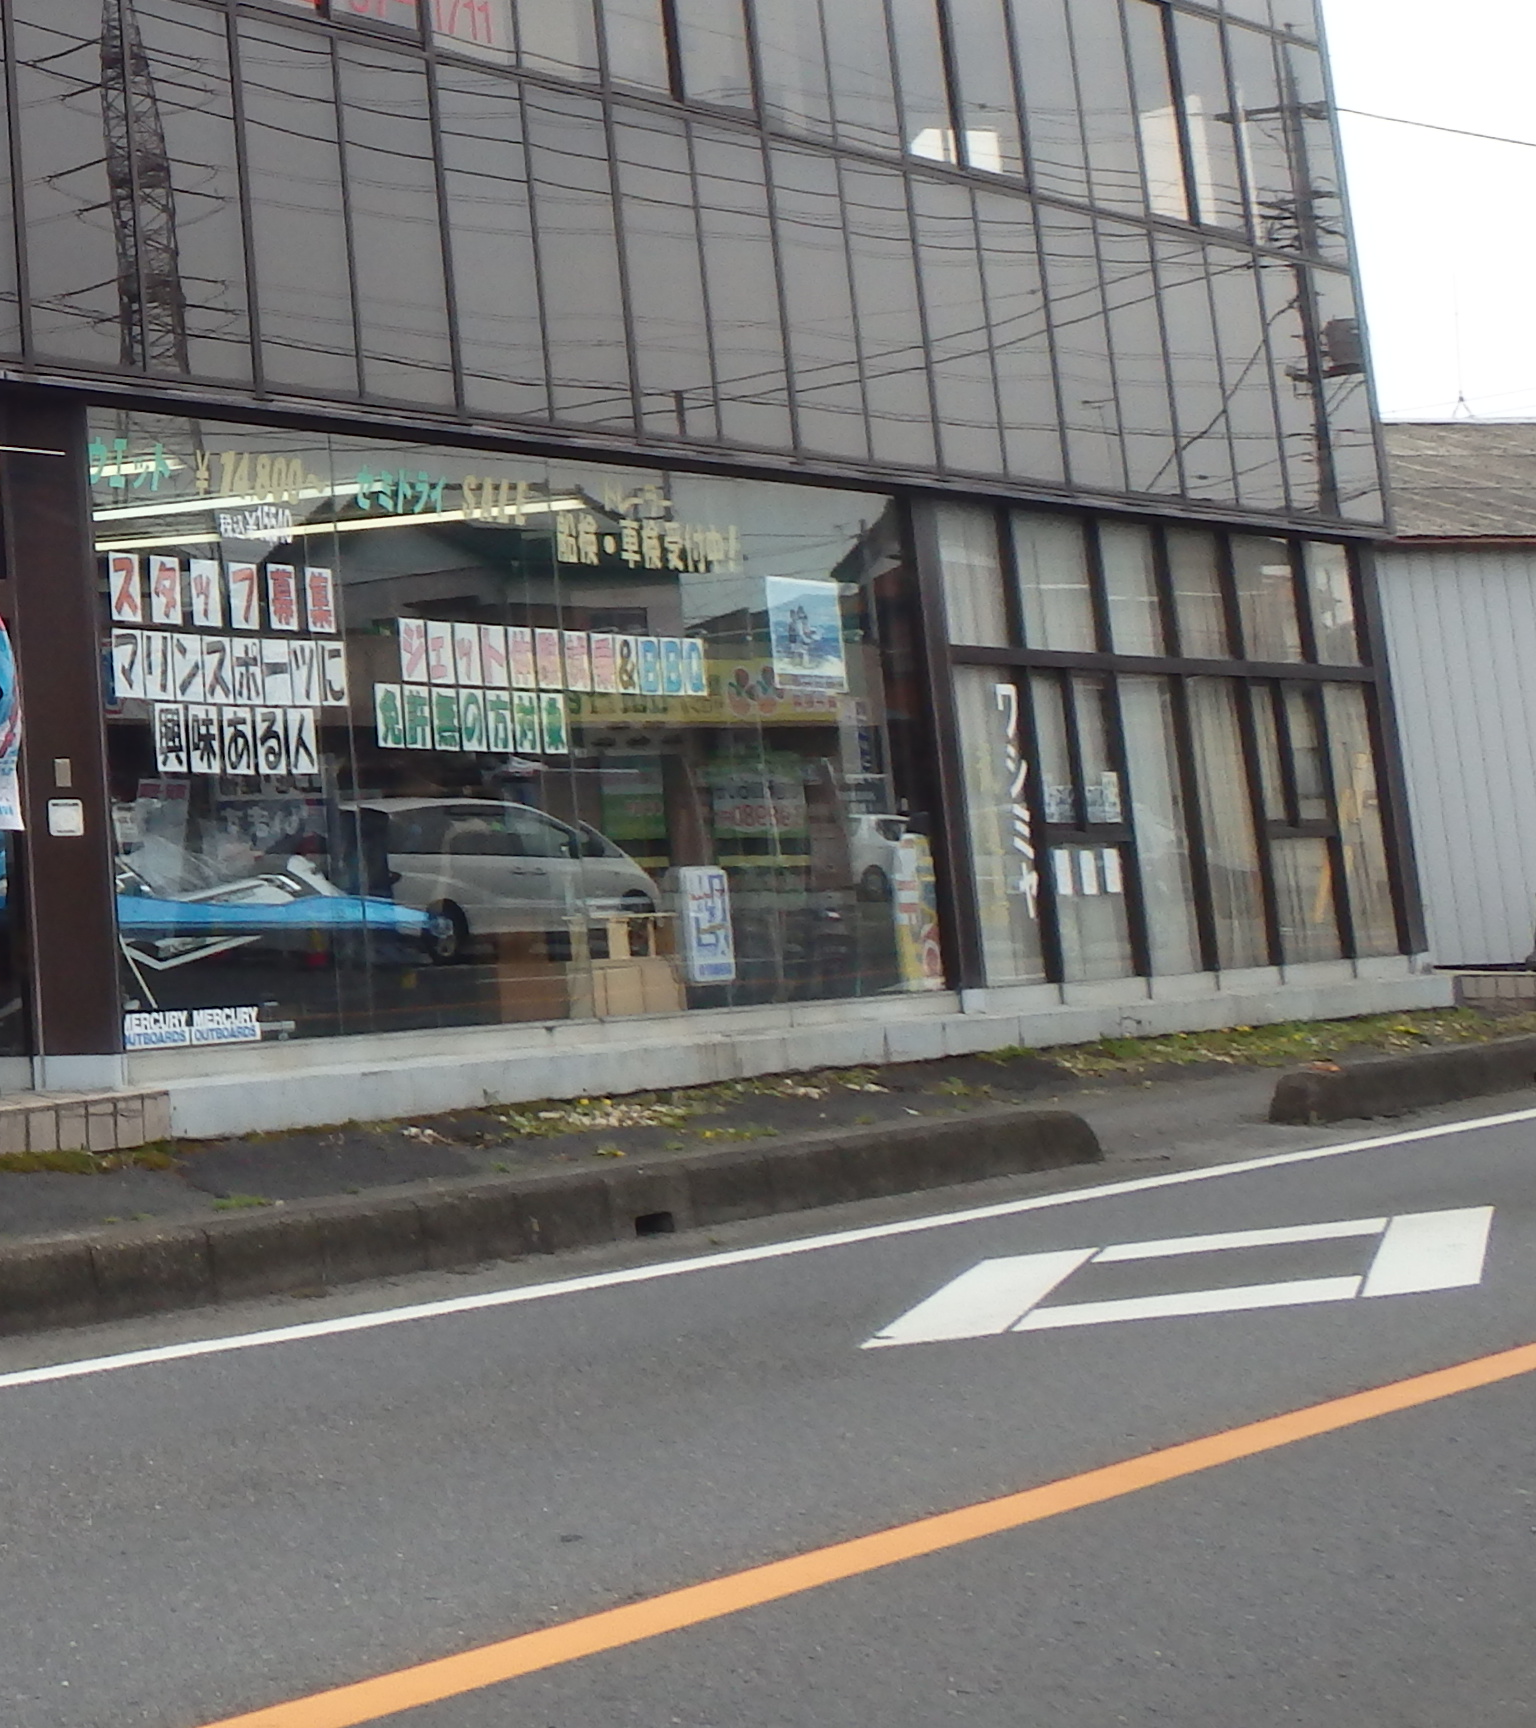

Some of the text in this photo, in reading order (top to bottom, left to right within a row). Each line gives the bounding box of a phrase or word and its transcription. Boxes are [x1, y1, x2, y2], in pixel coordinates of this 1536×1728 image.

[112, 555, 334, 628] スタッフ募集
[113, 632, 346, 703] マリンスポーツに
[158, 706, 316, 772] 興味ある人
[192, 1006, 259, 1028] MERCURY
